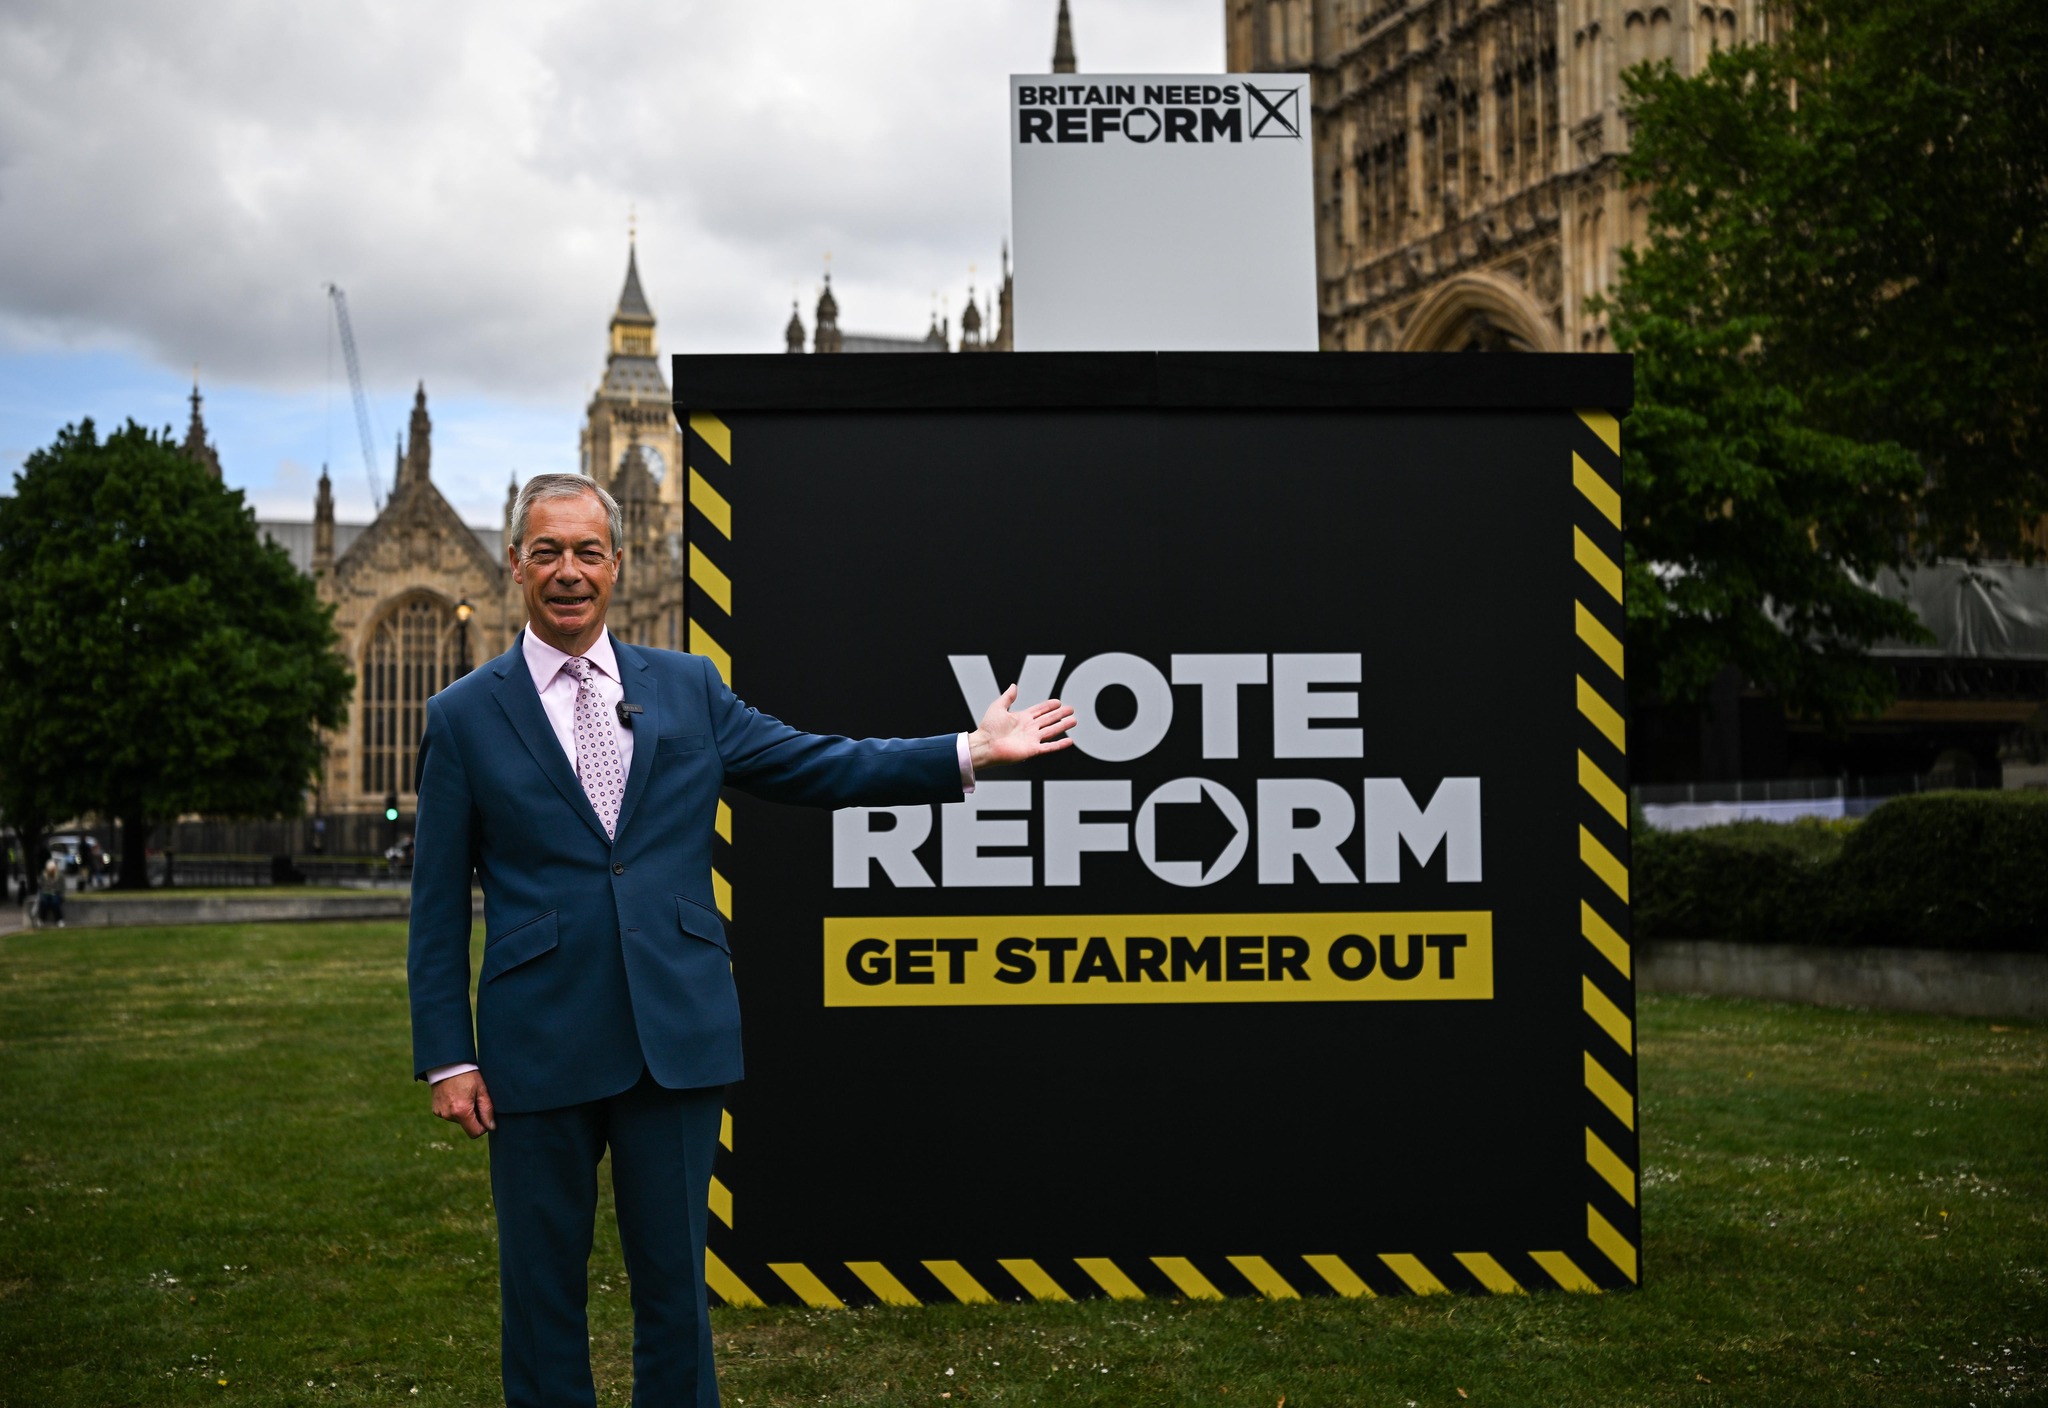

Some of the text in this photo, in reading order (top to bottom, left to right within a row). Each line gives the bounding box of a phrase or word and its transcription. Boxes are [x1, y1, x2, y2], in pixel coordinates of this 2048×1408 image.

[1019, 85, 1241, 105] BRITAIN NEEDS
[1019, 107, 1242, 143] REFORM
[947, 652, 1364, 761] VOTE
[832, 776, 1483, 888] REFORM
[845, 933, 1468, 986] GET STARMER OUT
